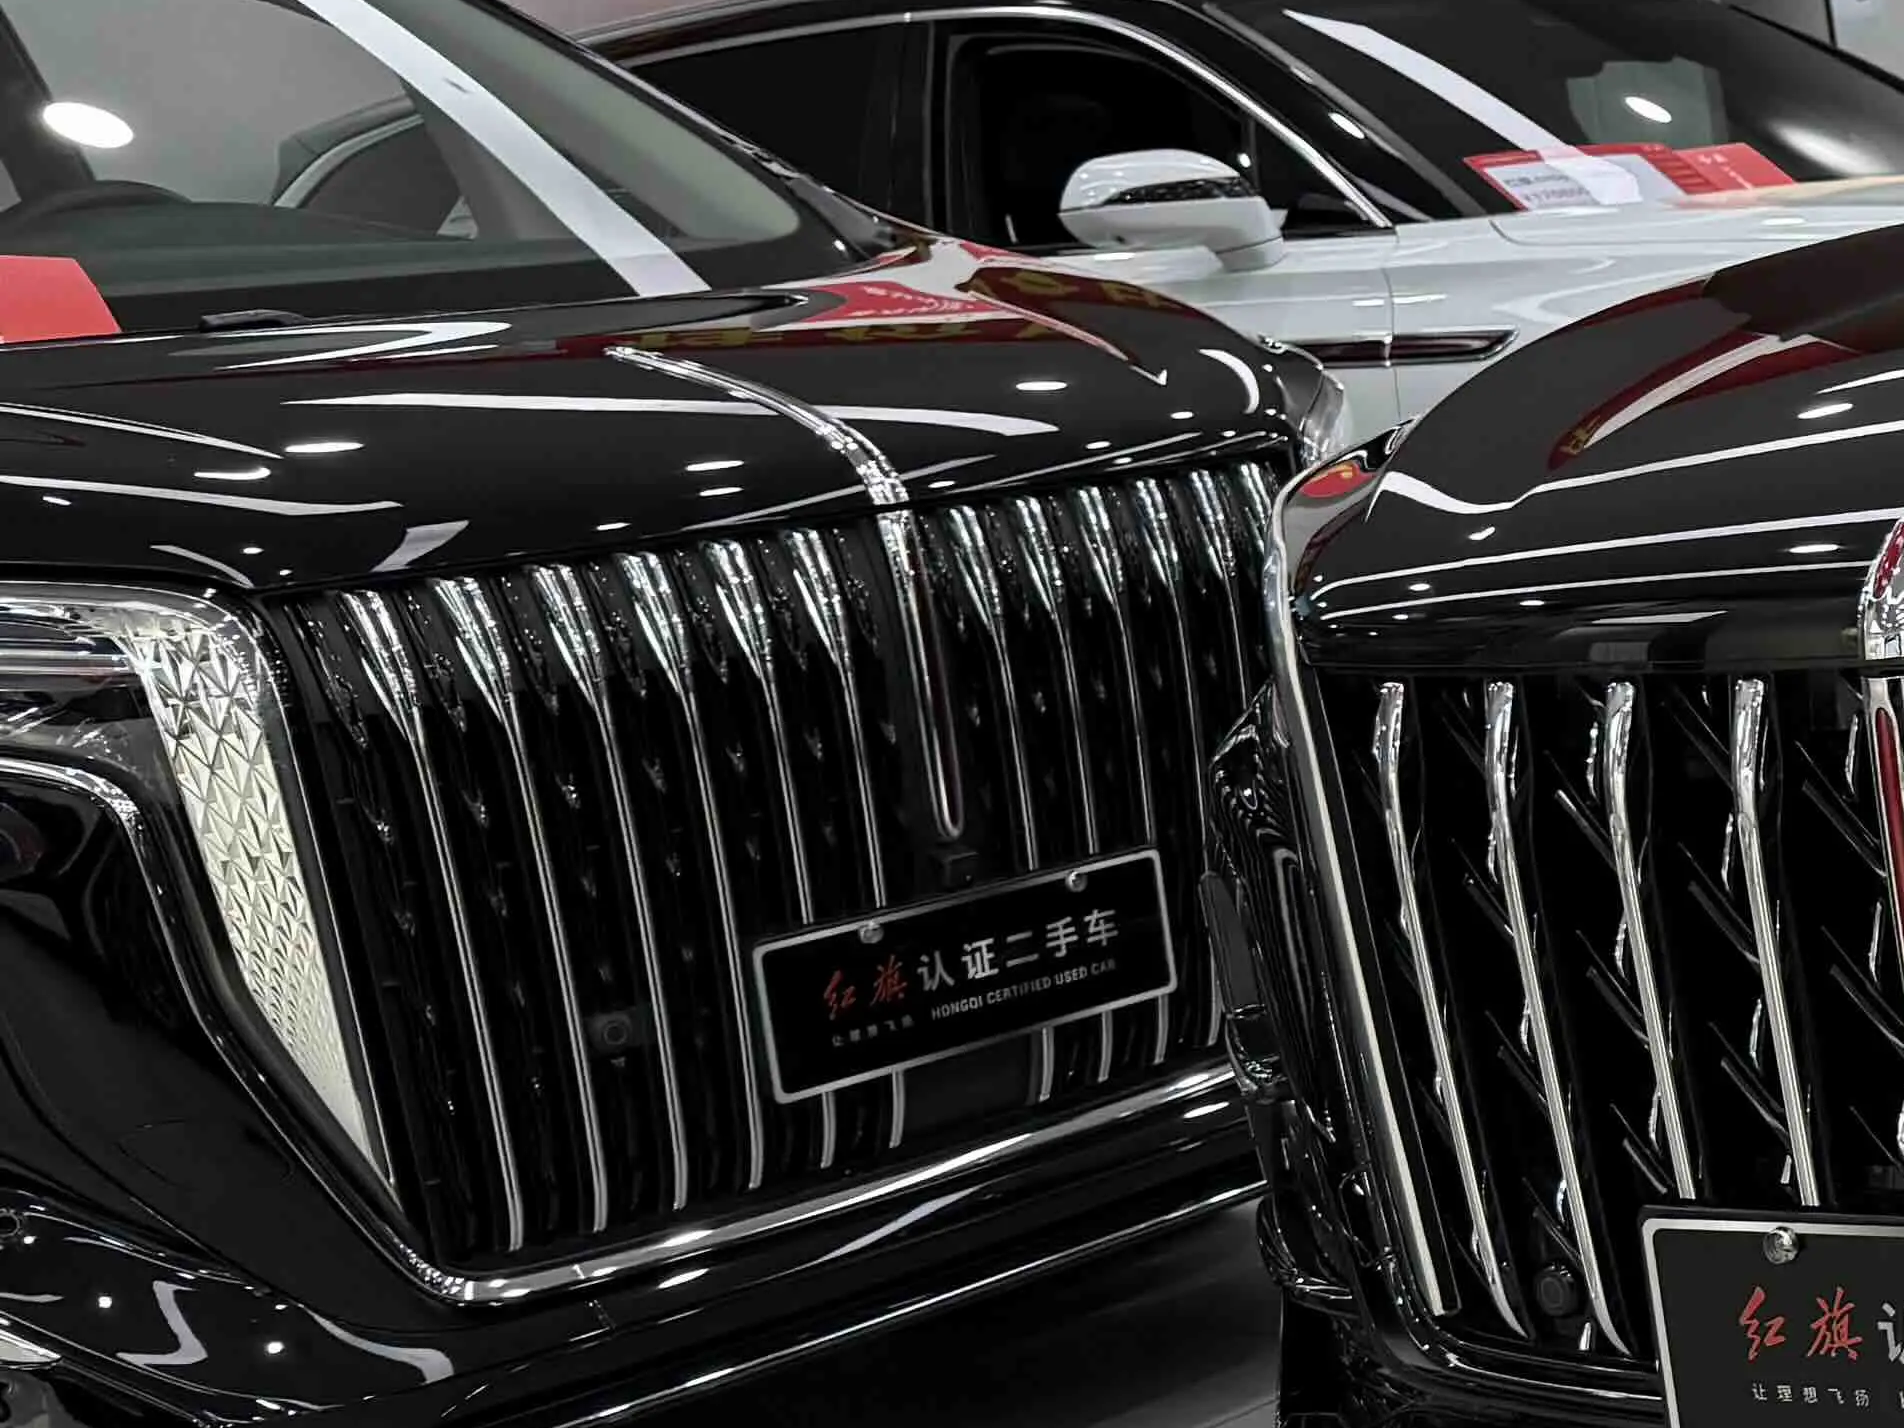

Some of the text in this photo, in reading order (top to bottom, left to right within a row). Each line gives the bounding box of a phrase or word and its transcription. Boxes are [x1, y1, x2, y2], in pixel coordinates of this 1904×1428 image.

[824, 908, 1119, 1021] 红旗认证二手车
[931, 958, 1117, 1021] HONGQI CERTIFIED USED CAR
[1751, 1382, 1870, 1408] 让理想飞扬
